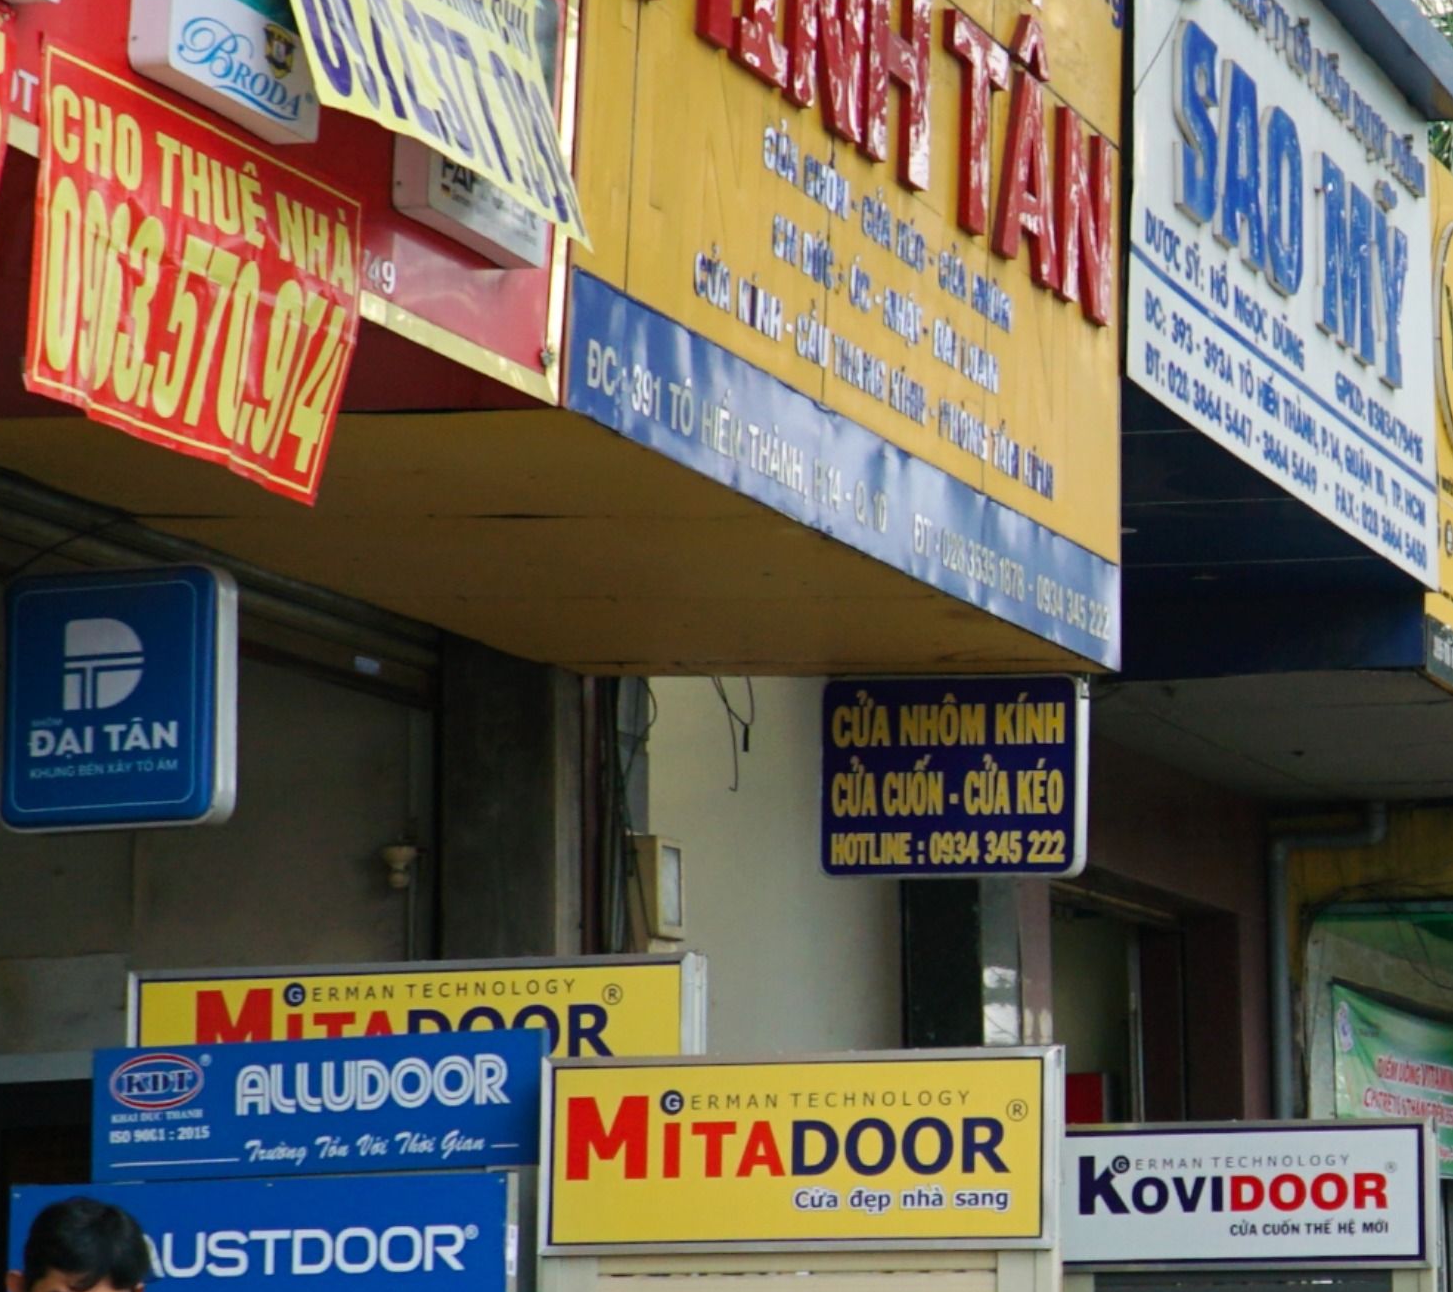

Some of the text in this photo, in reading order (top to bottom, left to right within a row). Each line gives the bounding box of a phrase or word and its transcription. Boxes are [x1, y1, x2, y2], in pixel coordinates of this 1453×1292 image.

[50, 83, 144, 191] CHO
[156, 129, 265, 247] THUÊ
[278, 191, 355, 295] NHÀ
[944, 9, 1114, 328] TÂN
[1173, 19, 1409, 390] SAO MỸ
[1146, 208, 1182, 272] DƯỢC
[1209, 262, 1230, 310] HỒ
[1234, 285, 1269, 344] NGỌC
[1273, 312, 1305, 372] DŨNG
[1171, 312, 1194, 356] 393
[1203, 337, 1235, 385] 393A
[1238, 359, 1254, 400] TÔ
[632, 364, 662, 422] 391
[669, 377, 695, 438] TÔ
[1193, 377, 1222, 425] 3864
[1225, 399, 1253, 451] 5447
[1263, 431, 1290, 475] 3864
[1292, 452, 1318, 496] 5449
[28, 717, 178, 760] ĐẠI TÂN
[833, 690, 1066, 747] CỬA NHÔM KÍNH
[832, 754, 1065, 817] CỬA CUỐN CỬA KÉO
[831, 830, 1066, 866] HOTLINE 0934 345 222
[283, 977, 577, 1008] GERMAN TECHNOLOGY
[234, 1053, 510, 1116] ALLUDOOR
[660, 1088, 971, 1116] GERMAN TECHNOLOGY
[109, 1130, 131, 1145] ISO
[178, 1125, 210, 1141] 2015
[441, 1129, 485, 1161] Gian
[565, 1094, 1011, 1180] MITADOOR
[1111, 1153, 1351, 1175] GERMAN TECHNOLOGY
[794, 1184, 1008, 1213] Cửa đẹp nhà sang
[1229, 1216, 1389, 1238] CỬA CUỐN THẾ HỆ MỚI
